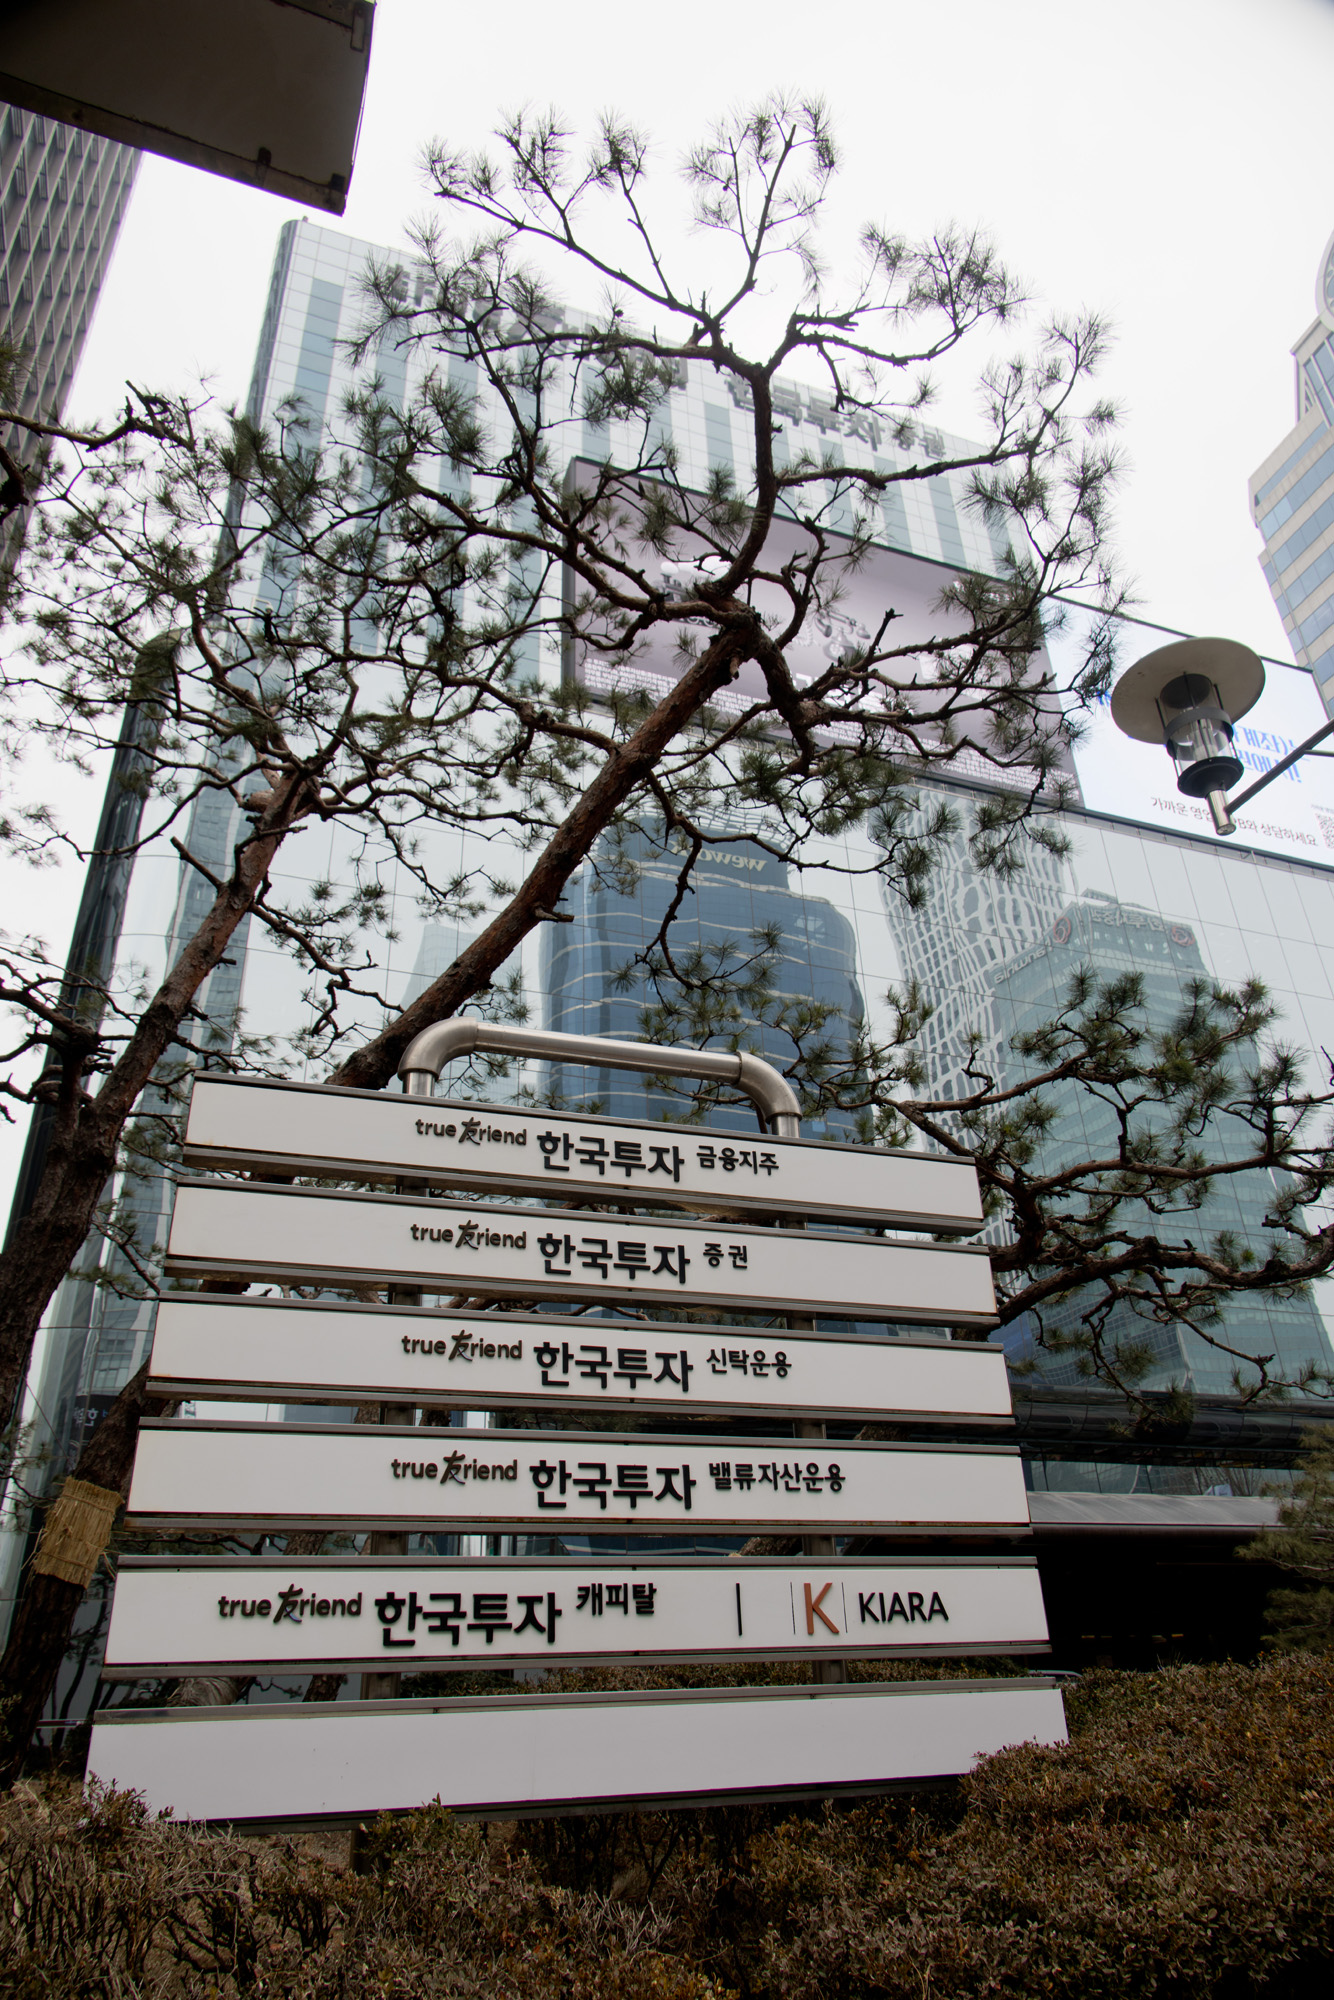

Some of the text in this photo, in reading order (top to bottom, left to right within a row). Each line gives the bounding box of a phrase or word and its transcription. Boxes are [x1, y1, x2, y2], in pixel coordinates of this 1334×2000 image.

[1151, 797, 1188, 817] 가까운
[1261, 823, 1319, 847] 상담하세요
[414, 1118, 457, 1138] true
[537, 1130, 685, 1183] 한국투자
[697, 1145, 780, 1177] 금융지주
[410, 1223, 454, 1244] true
[537, 1232, 691, 1285] 한국투자
[703, 1242, 748, 1270] 증권
[401, 1335, 447, 1356] true
[534, 1341, 694, 1393] 한국투자
[706, 1347, 793, 1379] 신탁운용
[391, 1458, 439, 1480] true
[529, 1459, 697, 1511] 한국투자
[708, 1461, 846, 1494] 밸류자산운용
[218, 1595, 272, 1620] true
[375, 1591, 563, 1650] 한국투자
[576, 1582, 658, 1617] 캐피탈
[803, 1582, 950, 1637] K KIARA
